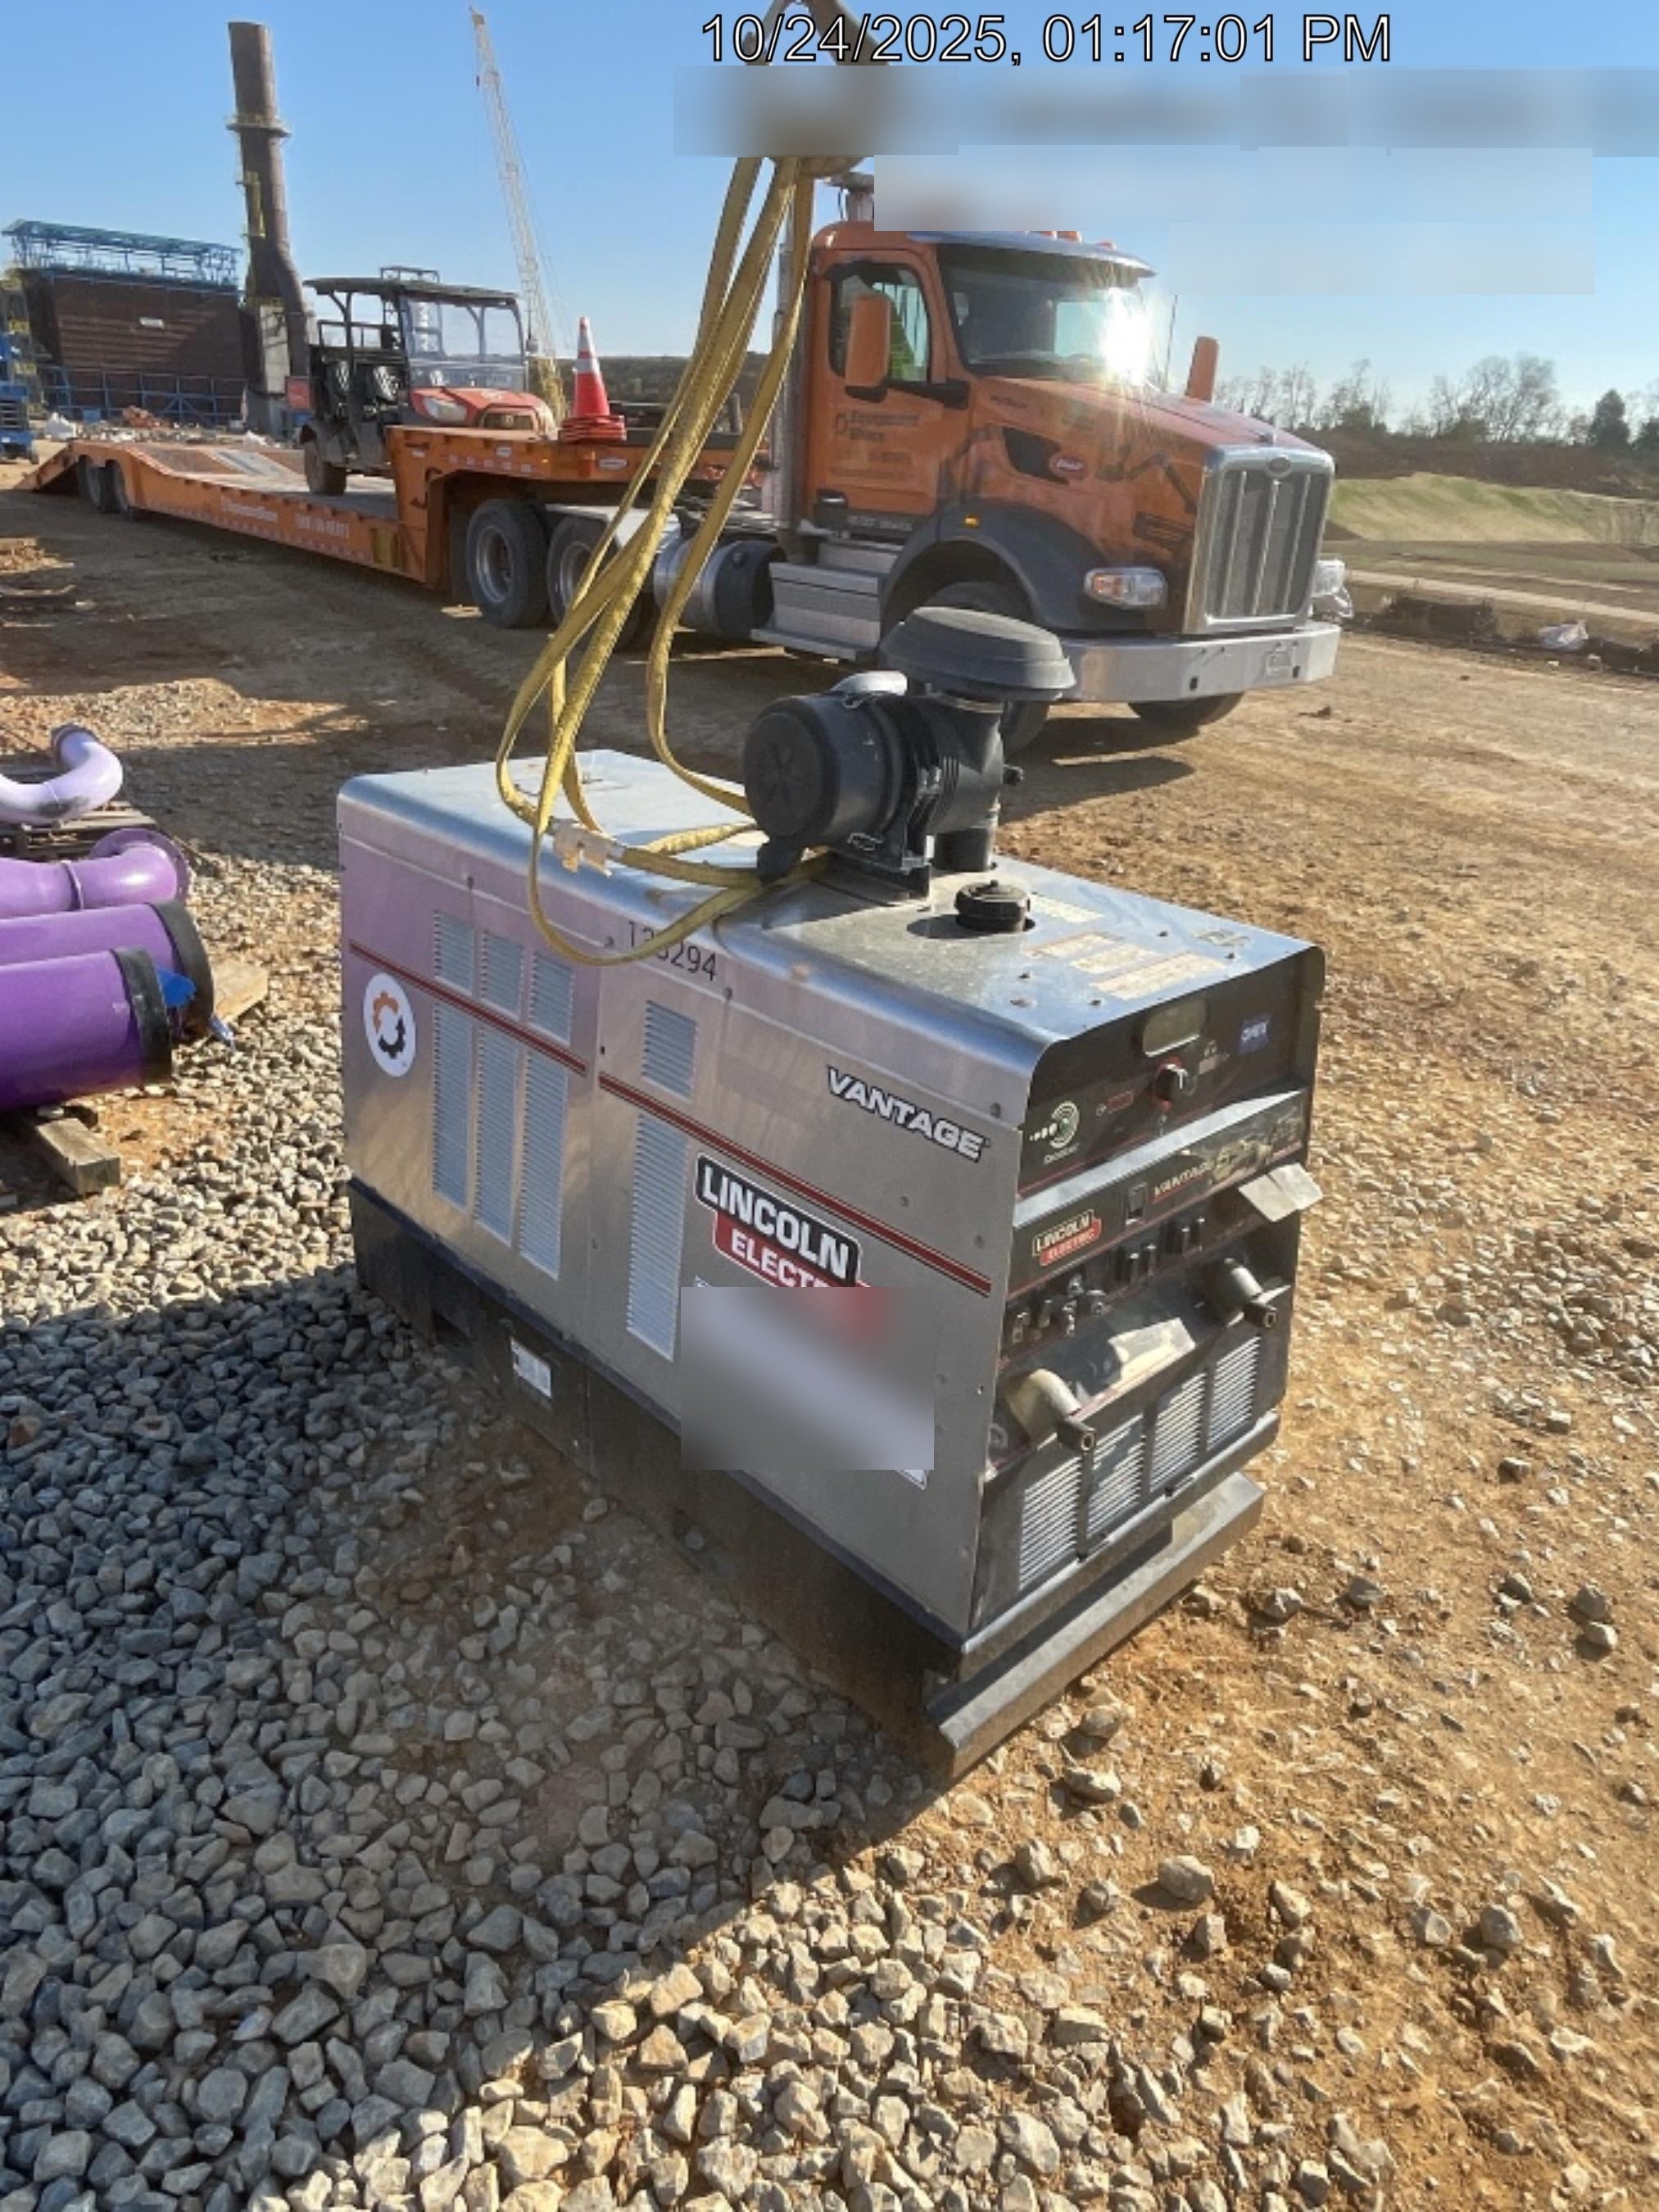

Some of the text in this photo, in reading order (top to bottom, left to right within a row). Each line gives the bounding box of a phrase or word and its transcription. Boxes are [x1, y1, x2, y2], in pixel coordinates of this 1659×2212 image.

[827, 1065, 984, 1163] VANTAGE
[702, 1164, 849, 1280] LINCOLN
[1036, 1212, 1090, 1253] LINCOLN
